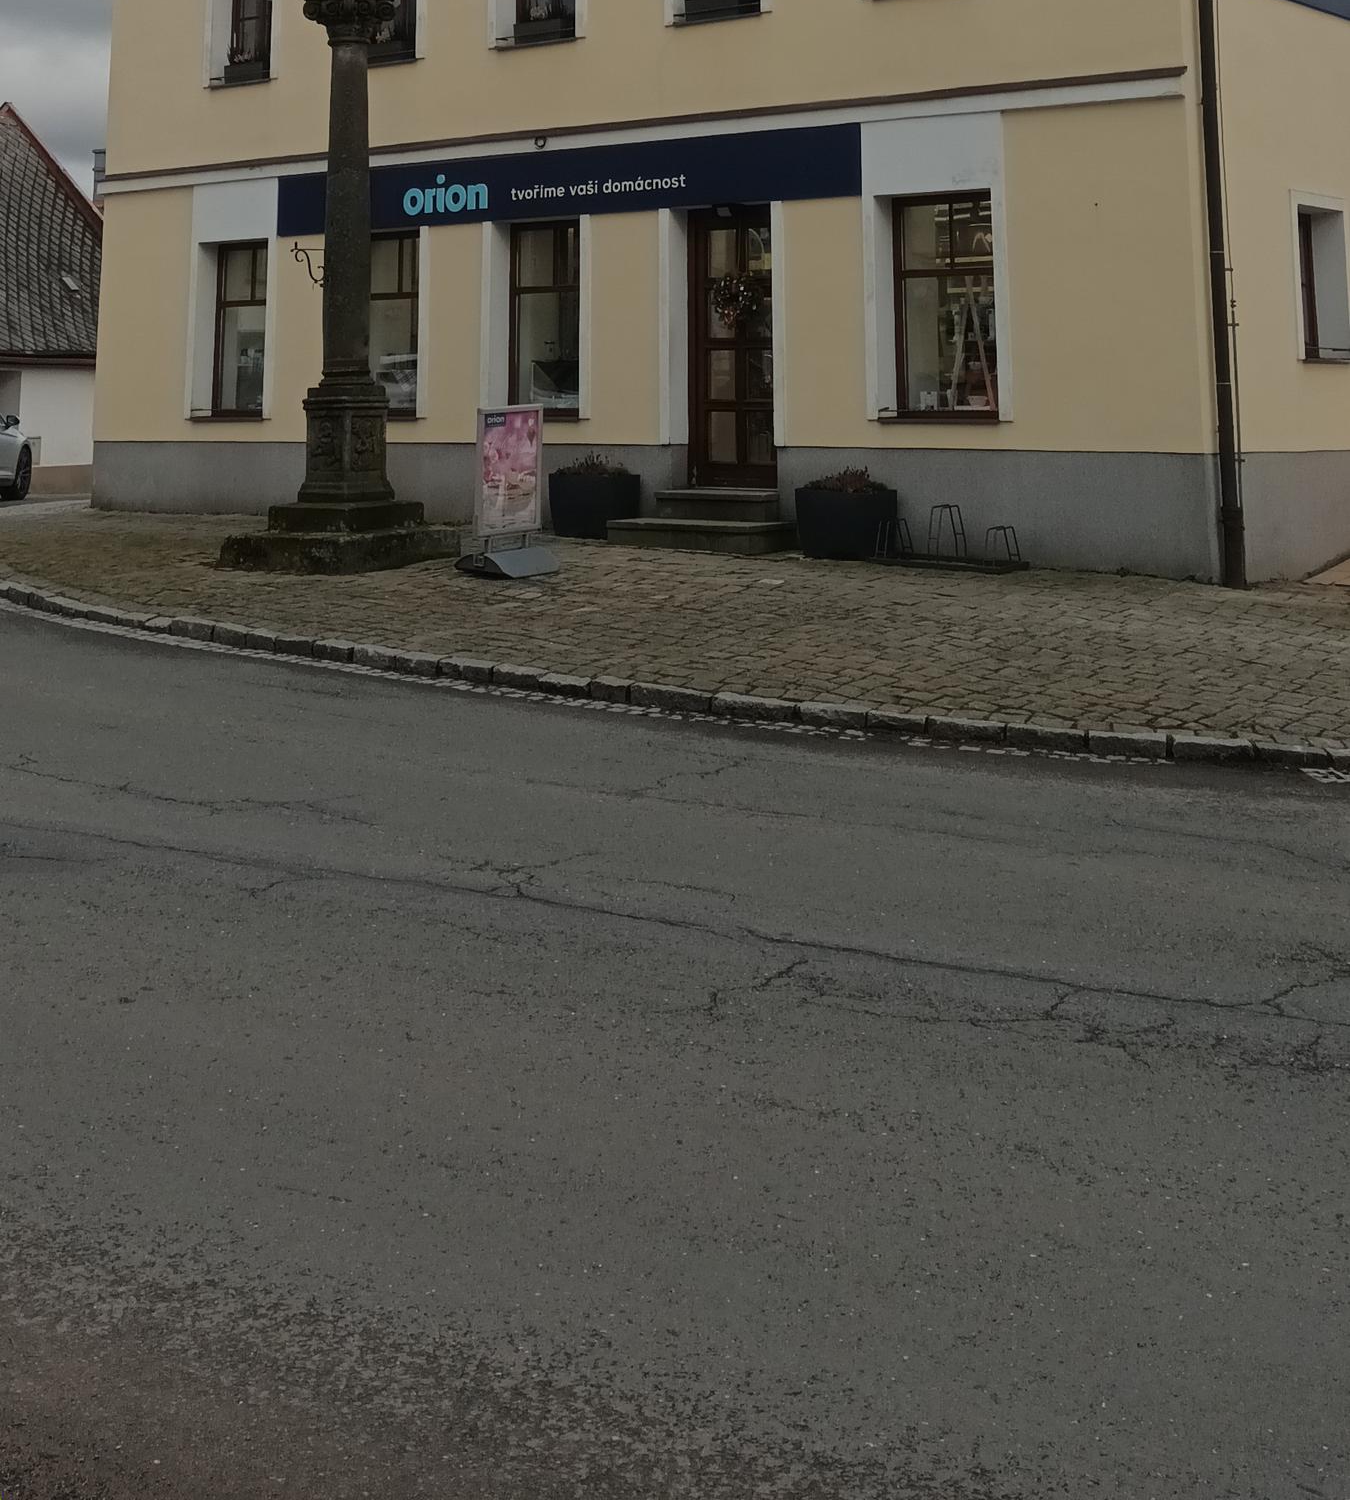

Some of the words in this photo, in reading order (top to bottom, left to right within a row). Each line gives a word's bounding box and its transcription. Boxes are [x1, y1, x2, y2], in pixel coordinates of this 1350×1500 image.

[403, 174, 488, 216] orion
[511, 184, 565, 200] tvoříme
[569, 180, 598, 196] vaši
[602, 174, 686, 193] domácnost
